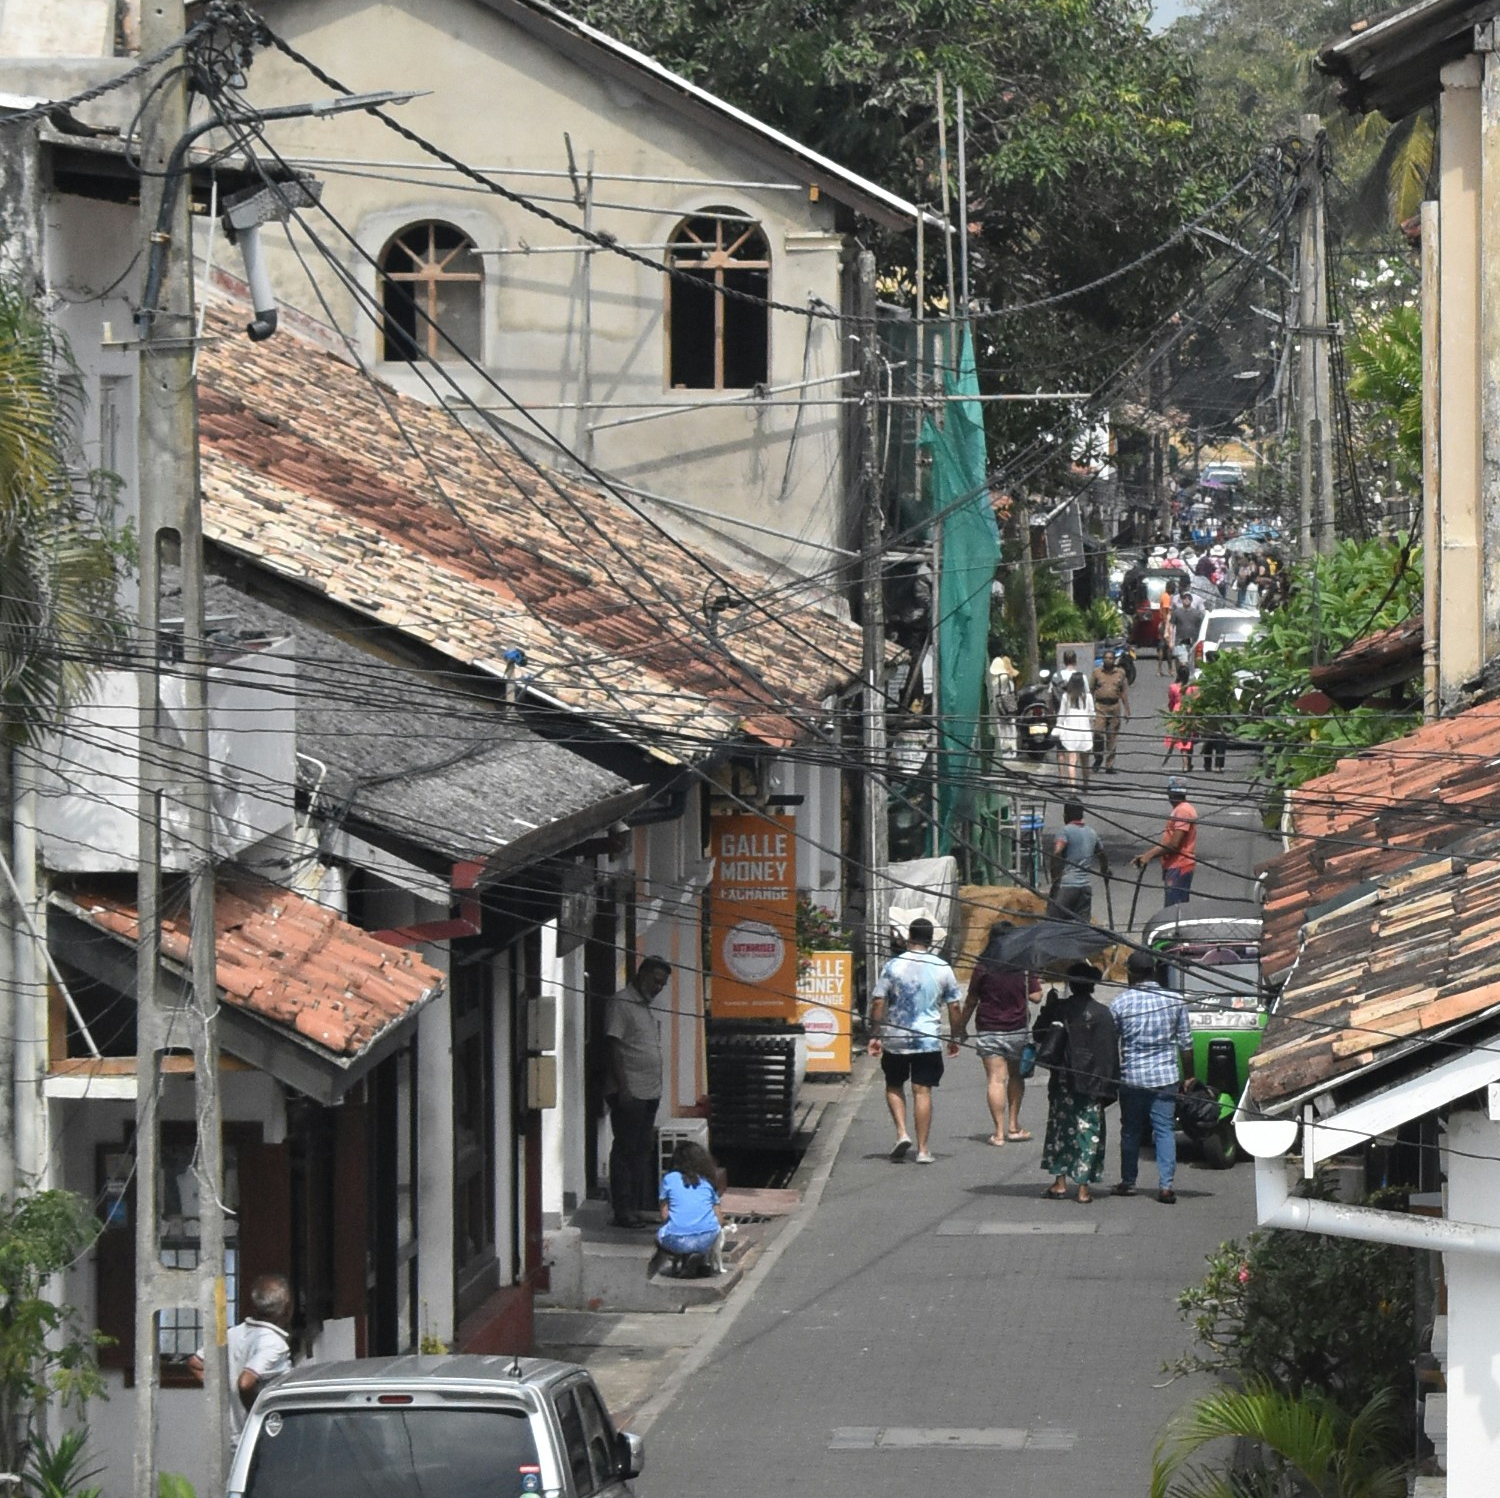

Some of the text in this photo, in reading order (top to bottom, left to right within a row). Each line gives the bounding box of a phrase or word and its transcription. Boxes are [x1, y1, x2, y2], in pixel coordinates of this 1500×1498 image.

[720, 834, 788, 857] GALLE
[720, 861, 788, 882] MONEY
[720, 887, 789, 901] EXCHANGE
[803, 960, 844, 977] ALLE
